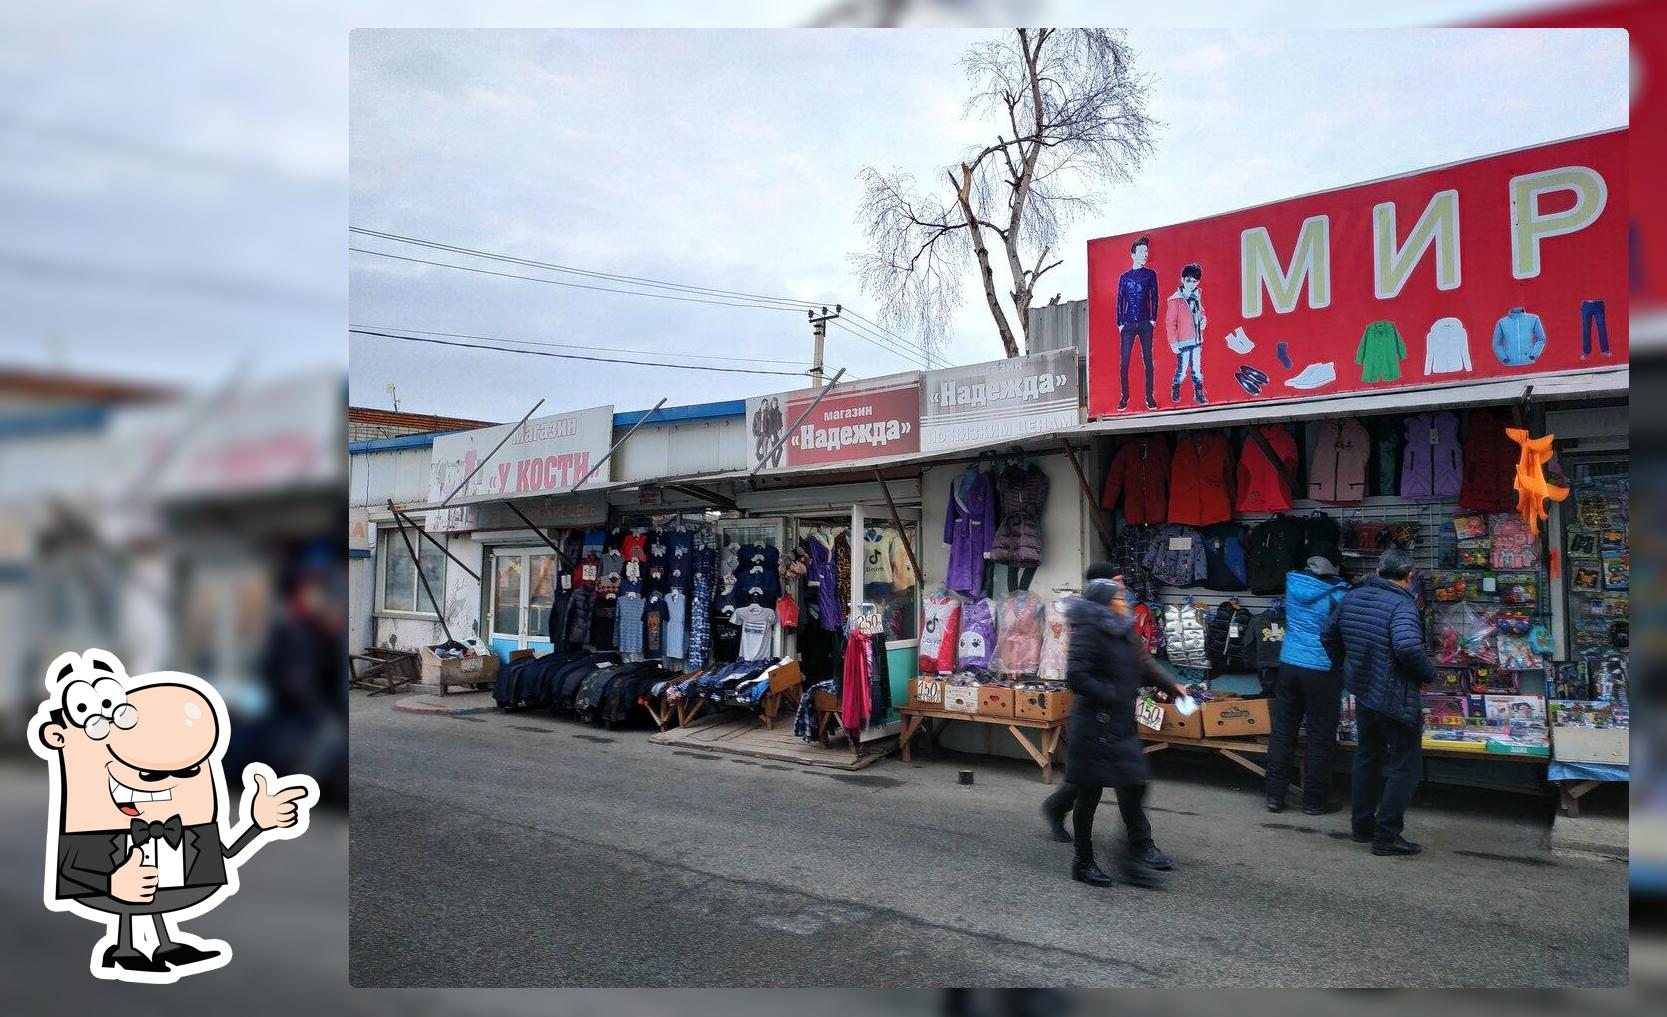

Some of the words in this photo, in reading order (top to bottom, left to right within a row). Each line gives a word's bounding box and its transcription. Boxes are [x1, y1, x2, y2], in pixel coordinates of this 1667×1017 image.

[1241, 165, 1608, 319] МИР
[931, 372, 1067, 407] «Надежда»
[823, 405, 873, 421] магазин
[791, 419, 911, 451] «Надежда»
[928, 430, 947, 445] ПО
[950, 422, 1013, 442] НИЗКИМ
[1017, 414, 1074, 436] ЦЕНАМ
